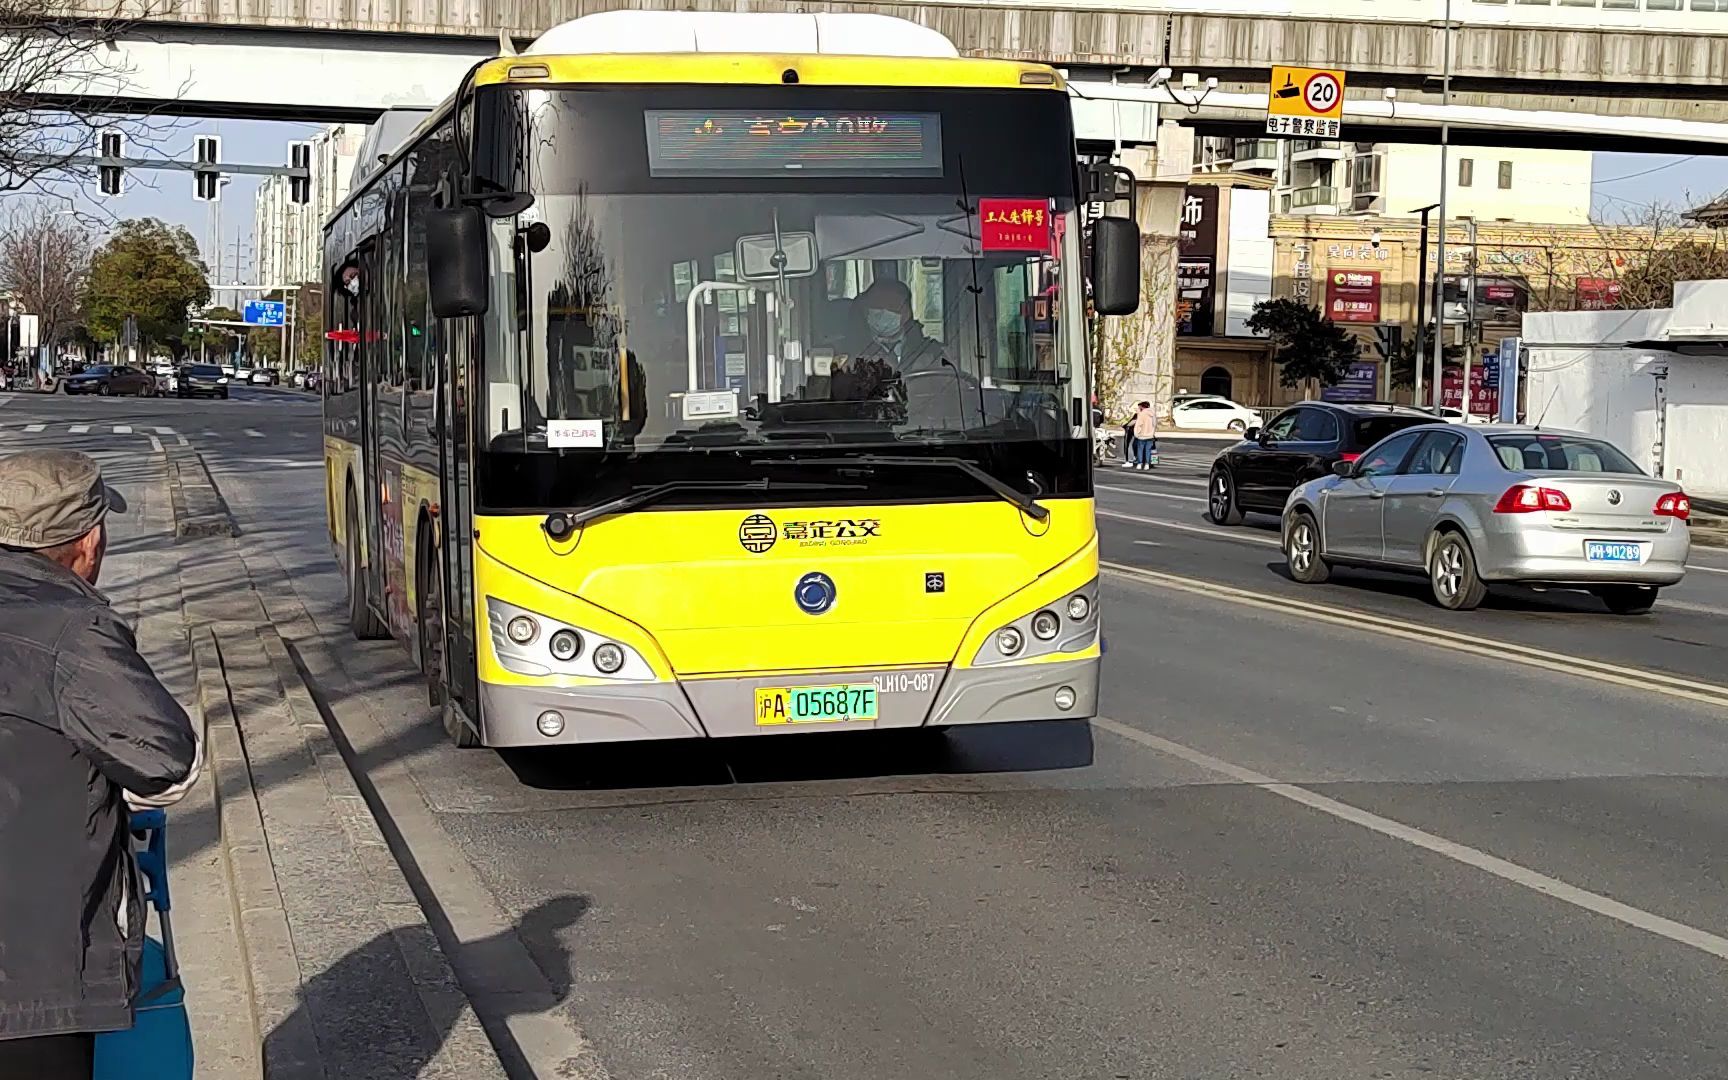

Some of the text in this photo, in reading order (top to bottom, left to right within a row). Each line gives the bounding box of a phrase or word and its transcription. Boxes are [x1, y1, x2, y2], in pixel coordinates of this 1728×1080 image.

[1312, 82, 1333, 102] 20
[1268, 117, 1339, 137] 电子警察监管
[782, 518, 882, 540] 嘉定公交
